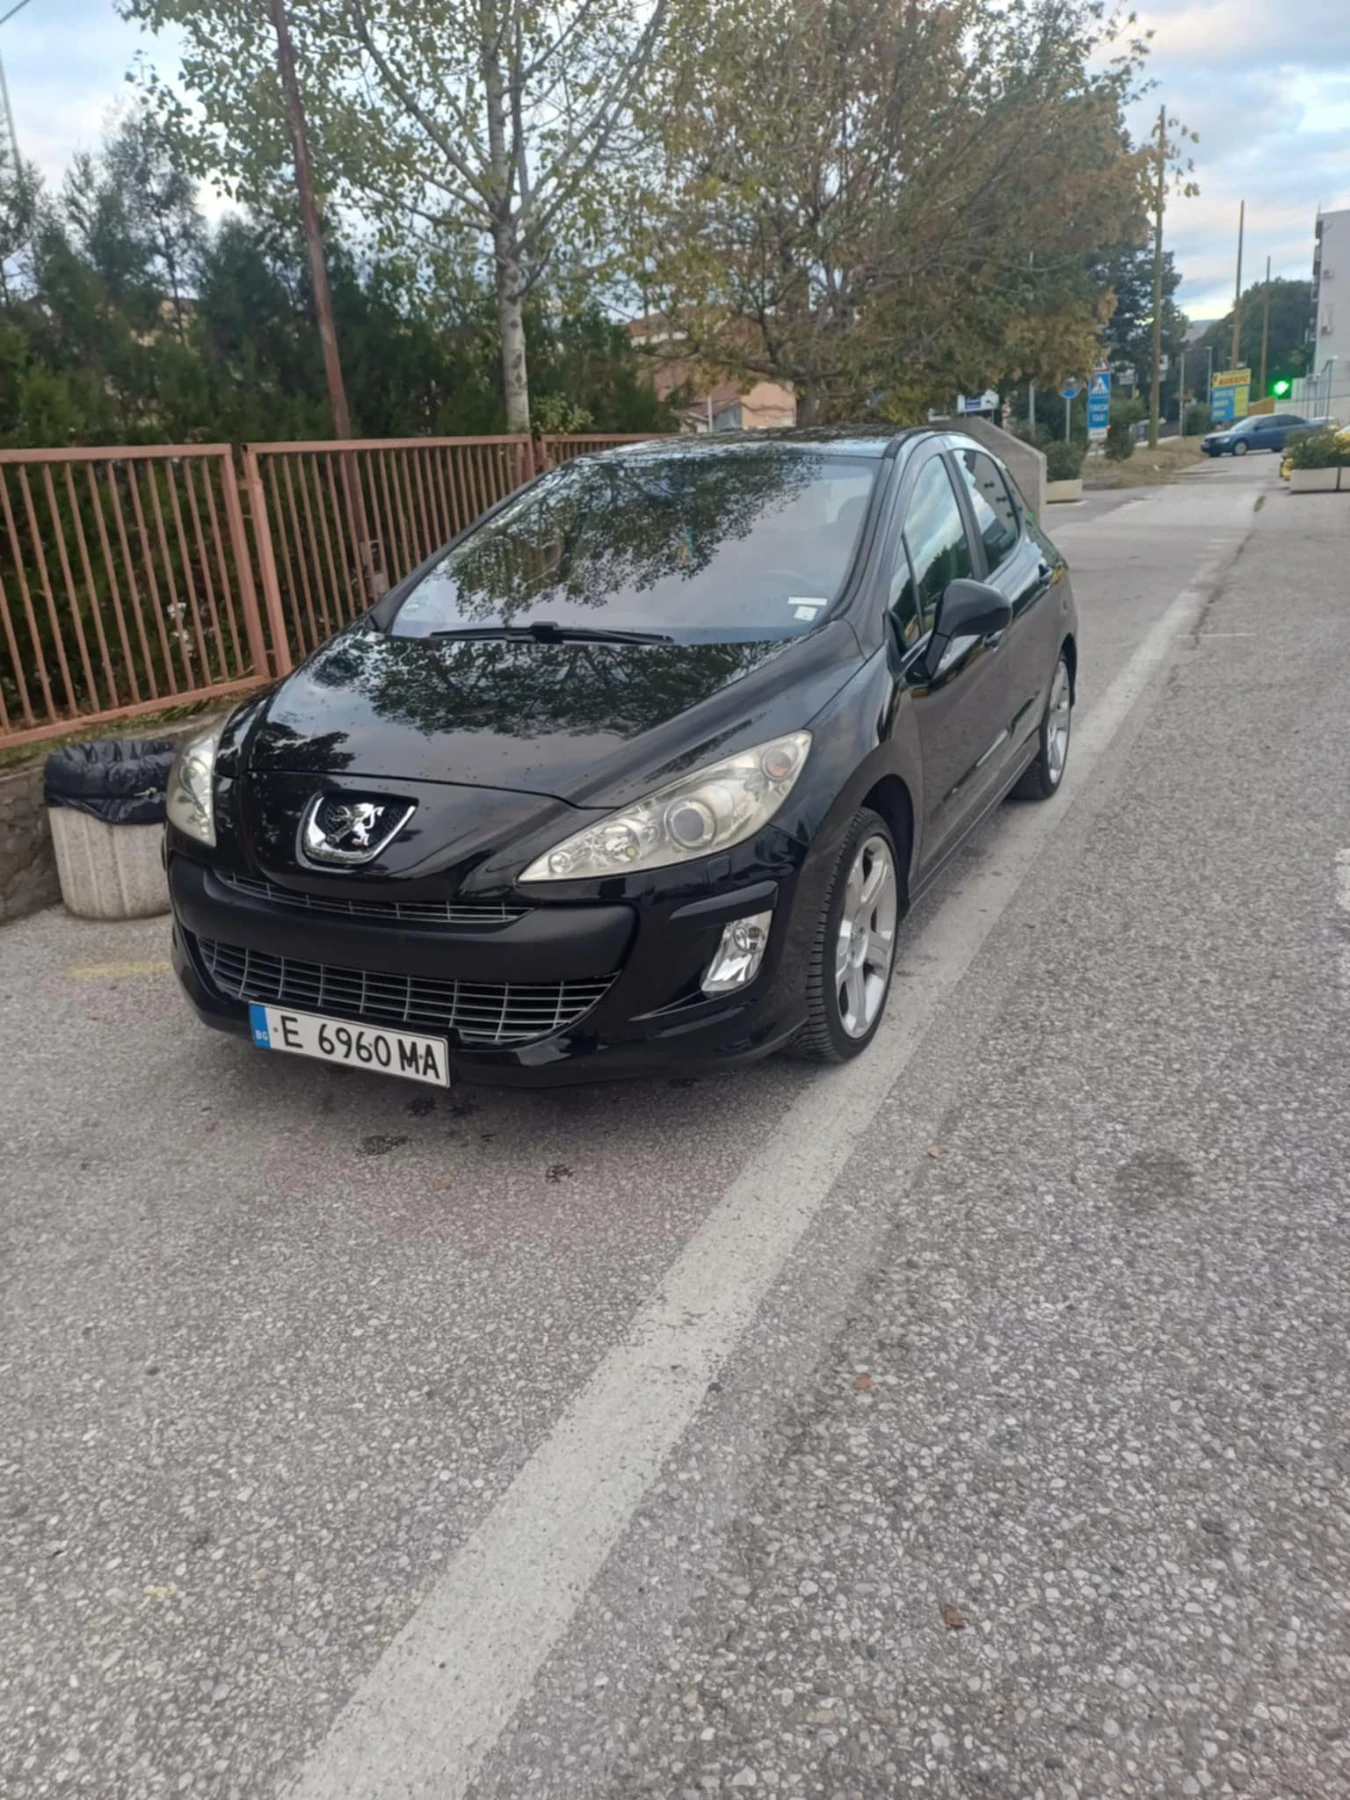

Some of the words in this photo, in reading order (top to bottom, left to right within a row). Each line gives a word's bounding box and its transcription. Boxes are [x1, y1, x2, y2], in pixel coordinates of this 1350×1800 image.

[255, 1029, 270, 1042] BG
[280, 1016, 303, 1048] E
[318, 1024, 392, 1067] 6960
[397, 1038, 440, 1079] MA
